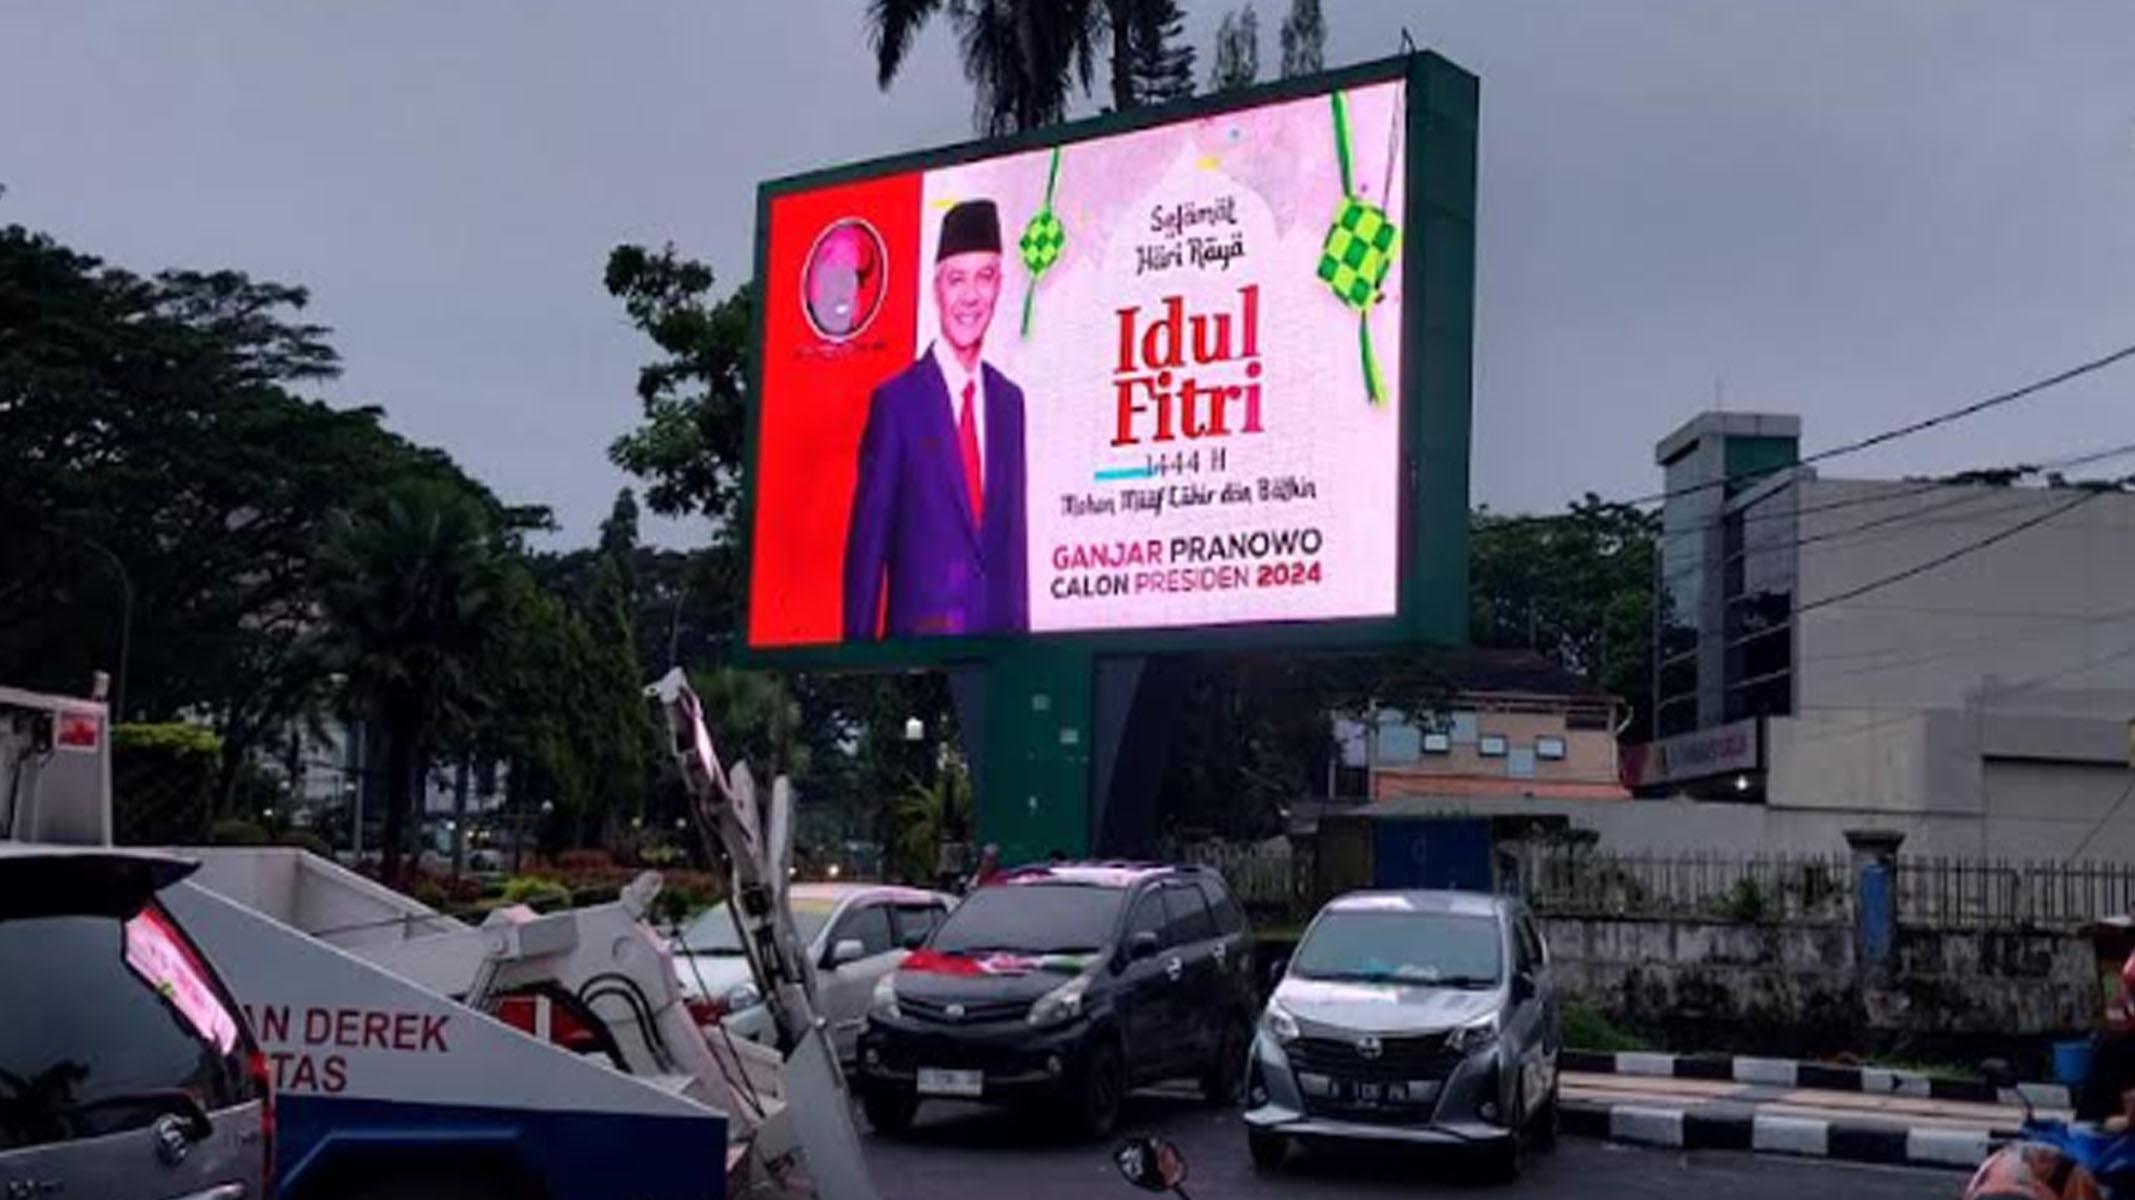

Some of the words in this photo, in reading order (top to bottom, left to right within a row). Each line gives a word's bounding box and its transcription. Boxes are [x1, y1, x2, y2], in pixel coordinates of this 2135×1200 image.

[1114, 285, 1259, 374] Idul
[1111, 361, 1264, 447] Fitri
[1146, 451, 1200, 476] 1444
[1210, 447, 1226, 471] H
[1052, 540, 1162, 570] GANJAR
[1170, 528, 1322, 563] PRANOWO
[1050, 575, 1129, 598] CALON
[1135, 566, 1248, 594] PRESIDEN
[1256, 561, 1321, 587] 2024
[305, 1007, 450, 1052] DEREK
